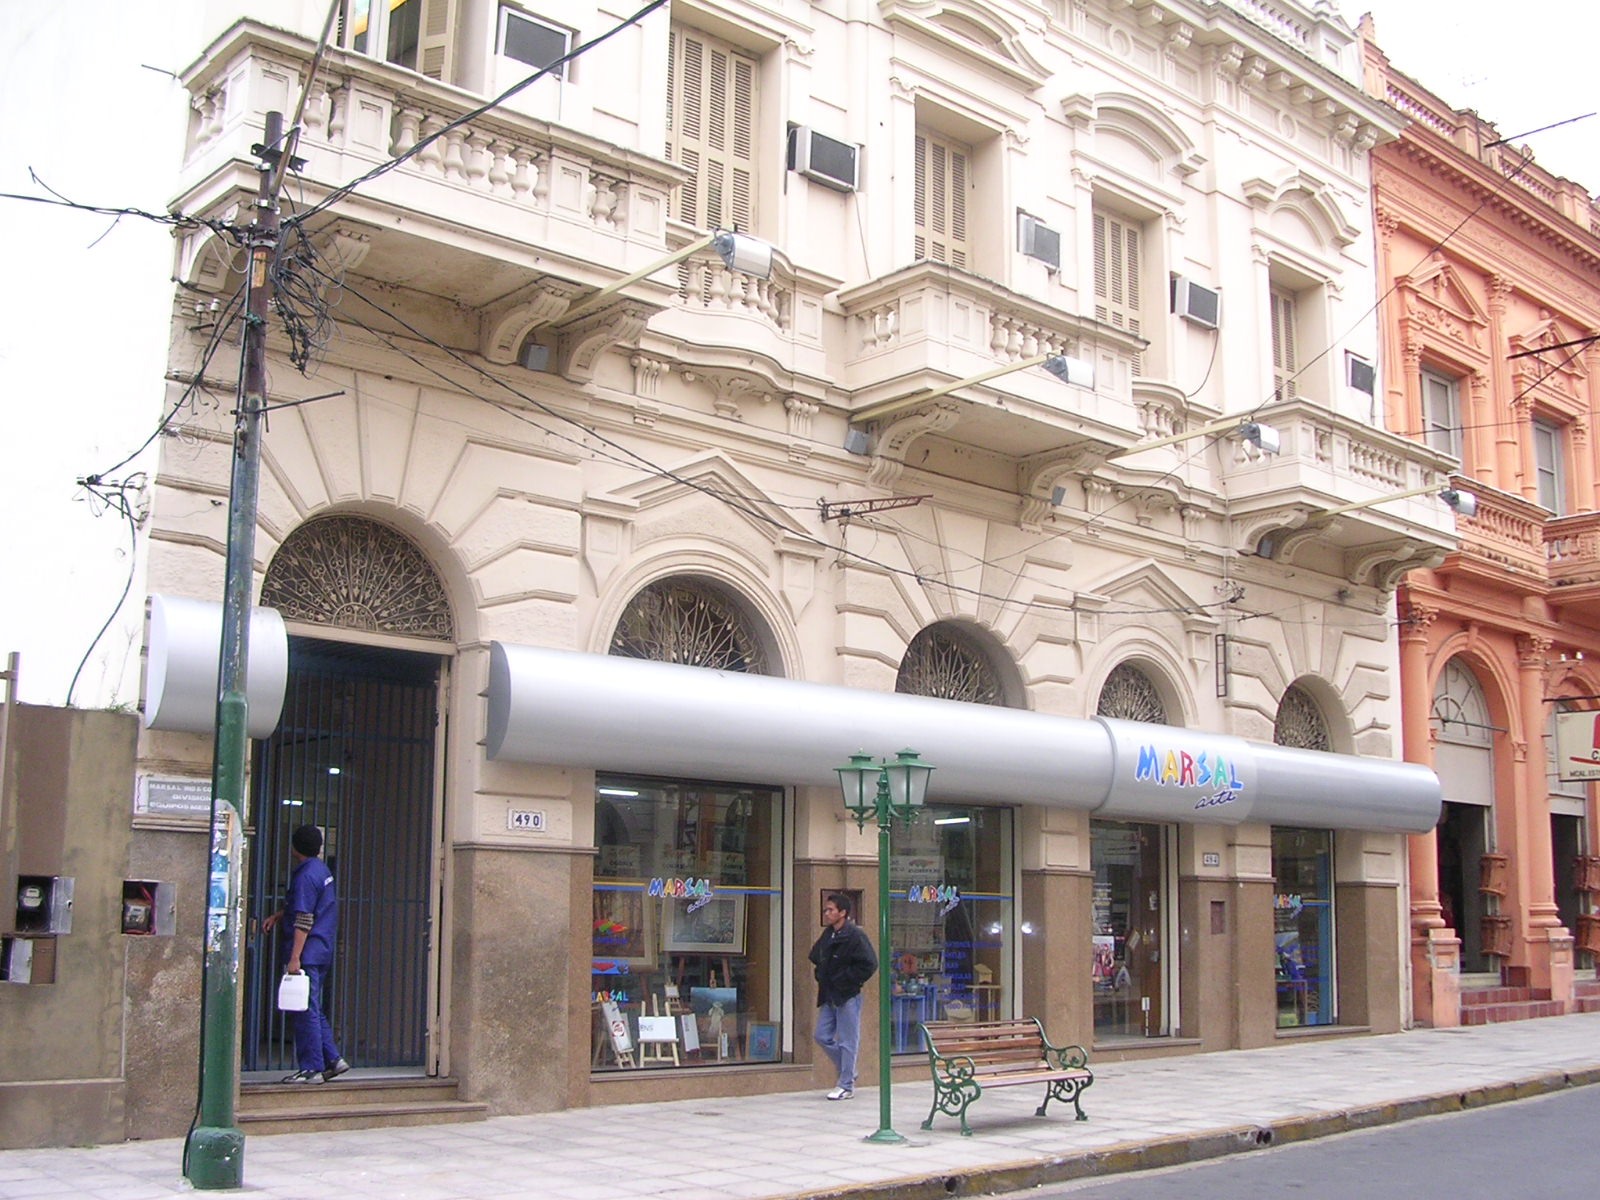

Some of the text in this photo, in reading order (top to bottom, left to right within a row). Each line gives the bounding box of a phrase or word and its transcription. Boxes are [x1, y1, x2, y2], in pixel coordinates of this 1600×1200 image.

[1591, 750, 1600, 760] C
[1135, 744, 1243, 790] MARSAL
[515, 814, 540, 826] 490
[648, 877, 713, 897] MARSAL
[908, 884, 960, 903] MARSAL
